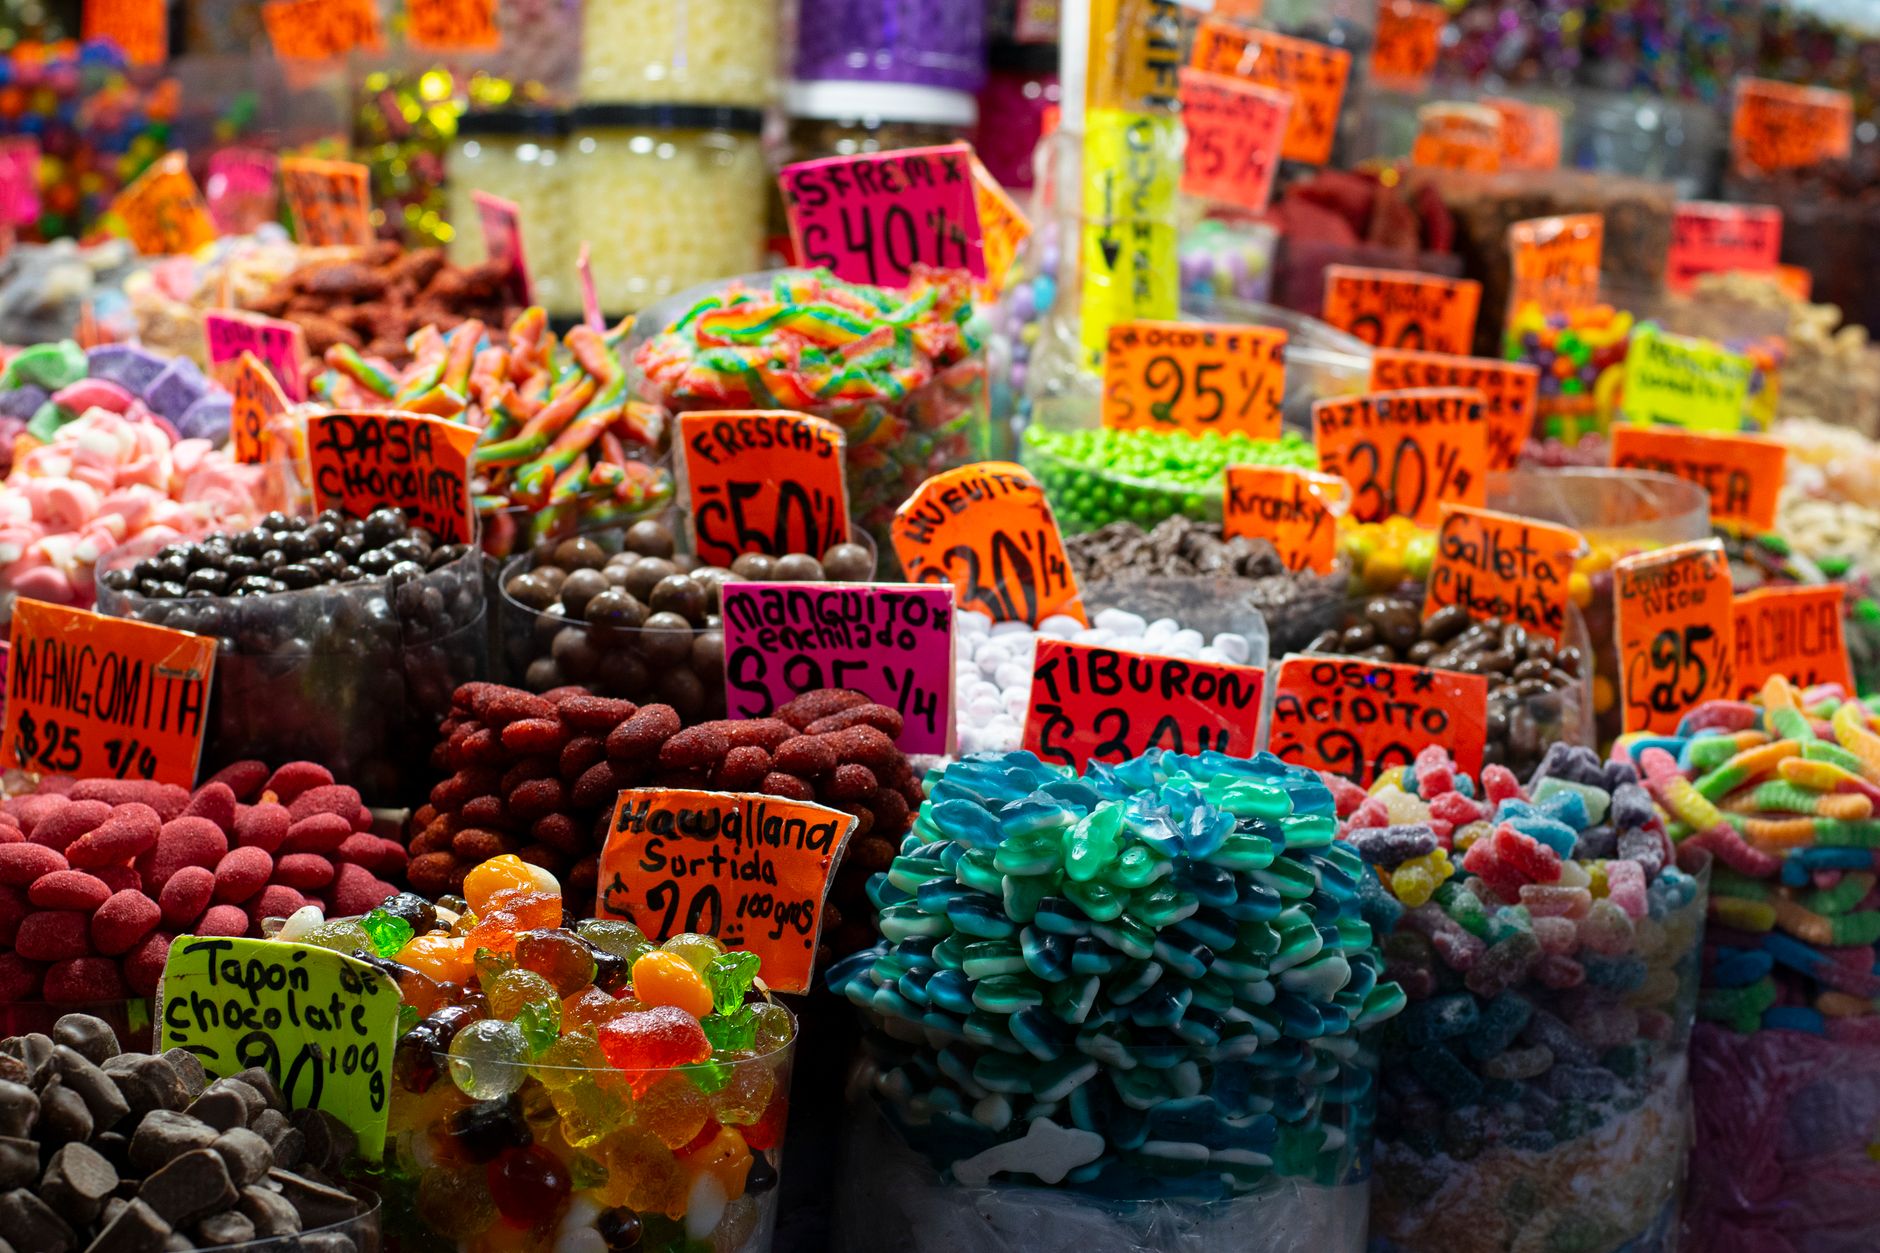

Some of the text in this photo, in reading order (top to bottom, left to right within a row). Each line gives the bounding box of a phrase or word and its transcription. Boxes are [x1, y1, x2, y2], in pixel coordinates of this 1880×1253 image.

[316, 414, 433, 464] PASA
[692, 416, 833, 464] FRESCAS
[14, 708, 83, 772] $25
[639, 838, 778, 887] Surtida
